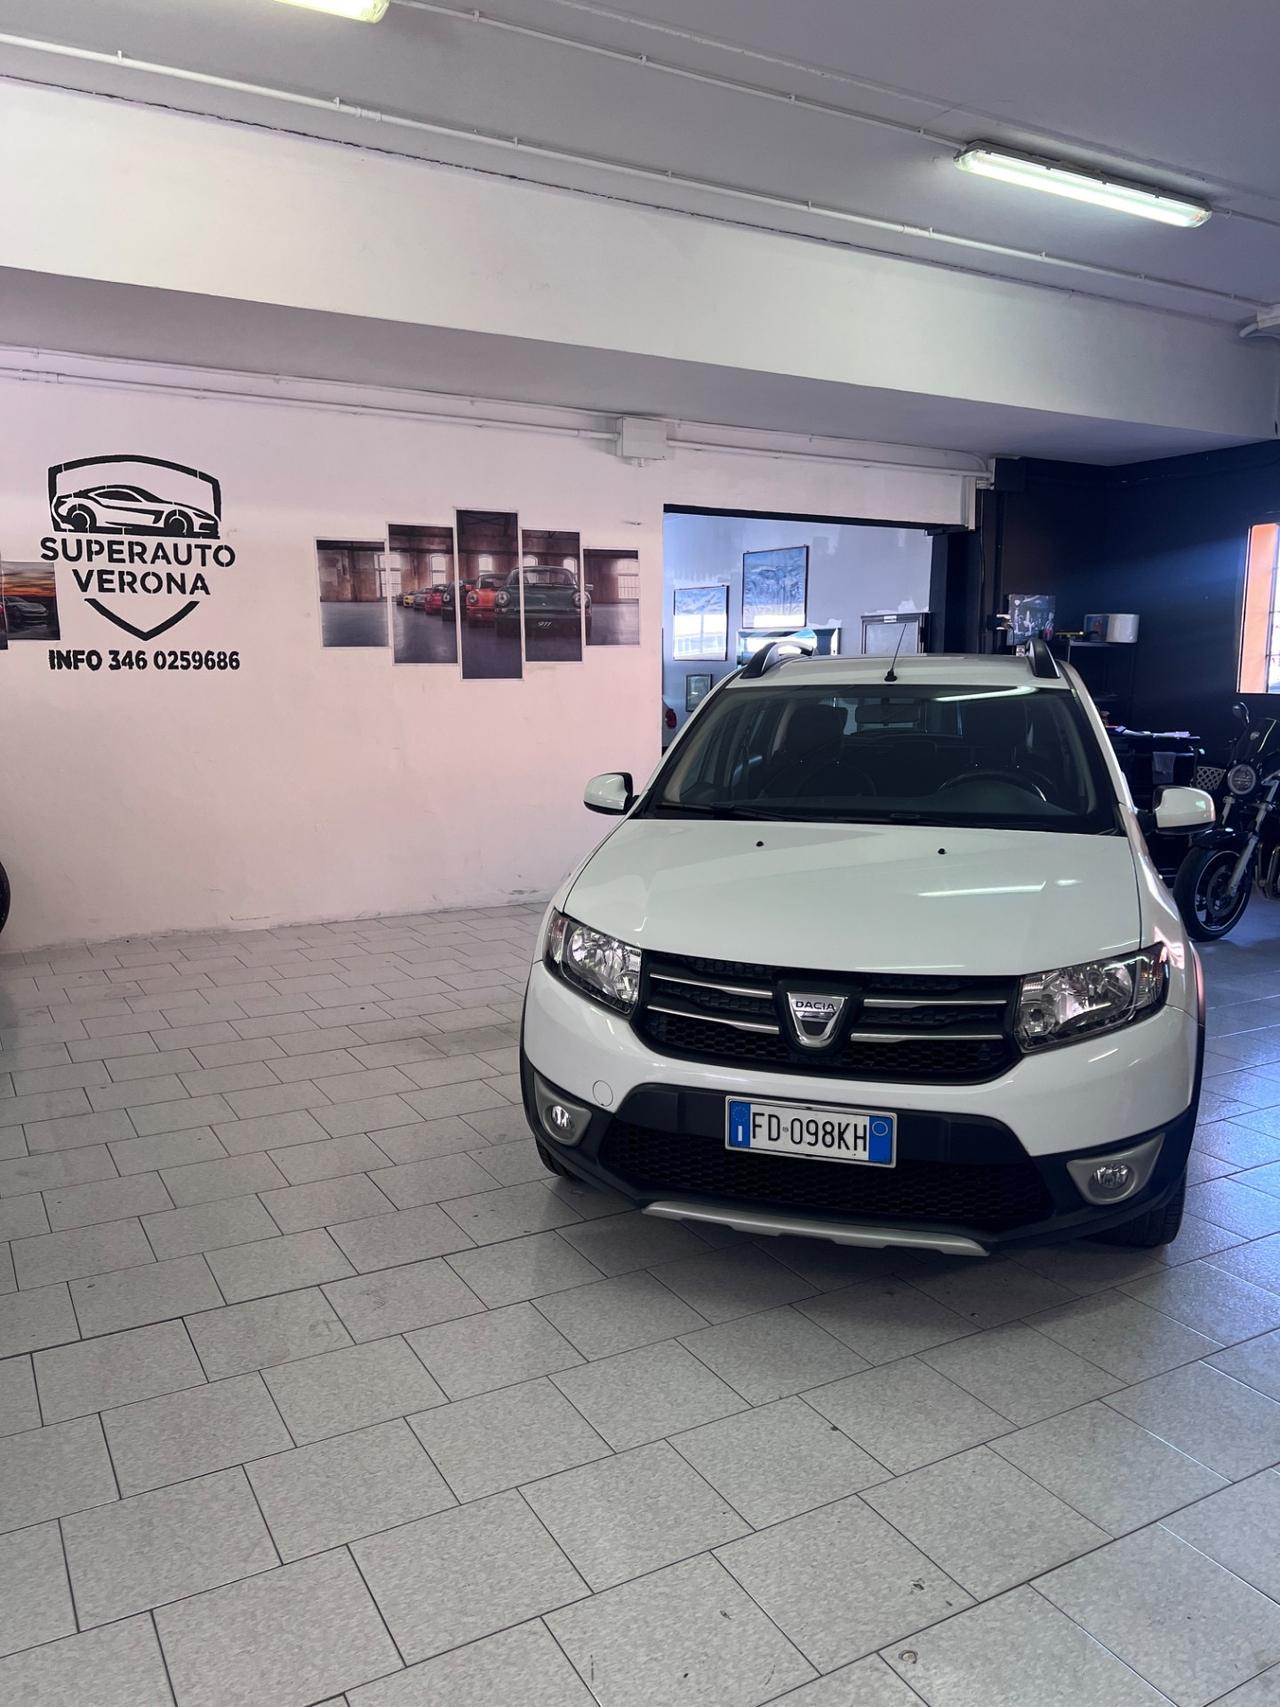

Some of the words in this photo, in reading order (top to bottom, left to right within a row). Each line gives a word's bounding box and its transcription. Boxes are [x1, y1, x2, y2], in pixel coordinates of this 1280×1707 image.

[40, 537, 236, 567] SUPERAUTO
[72, 569, 211, 595] VERONA
[48, 649, 103, 671] INFO
[108, 650, 148, 670] 346
[153, 650, 241, 671] 0259686
[795, 1001, 836, 1011] DACIA
